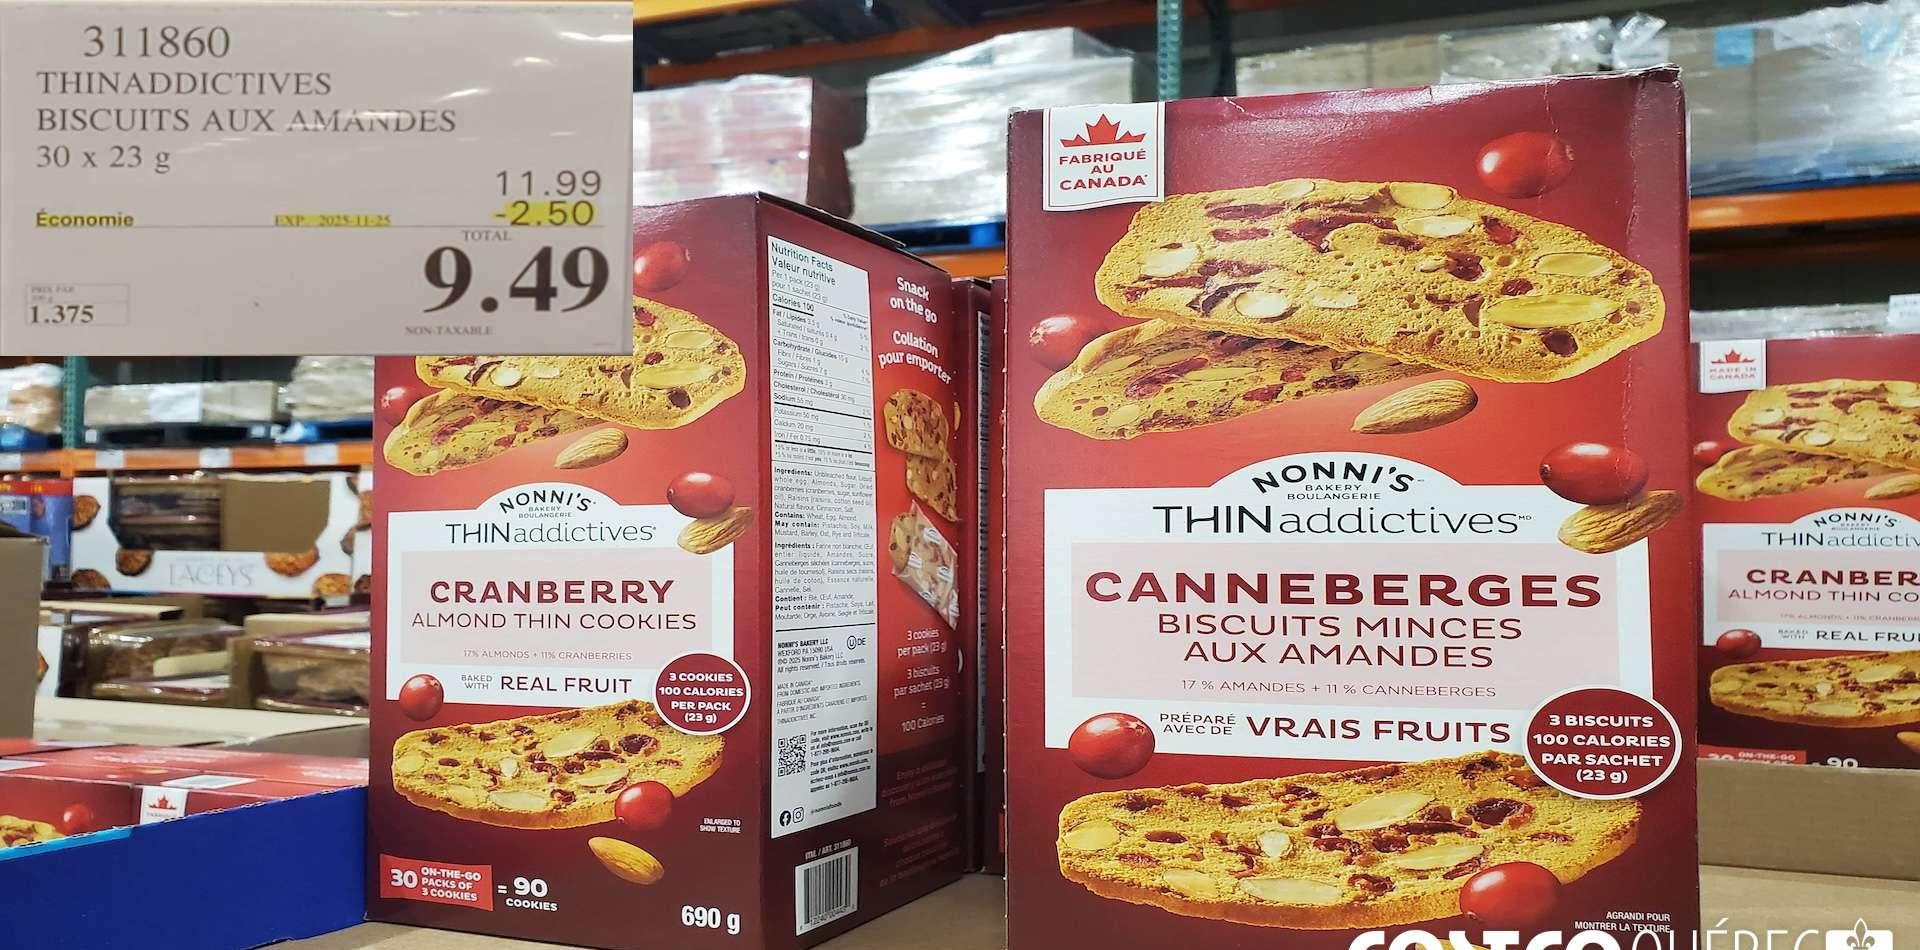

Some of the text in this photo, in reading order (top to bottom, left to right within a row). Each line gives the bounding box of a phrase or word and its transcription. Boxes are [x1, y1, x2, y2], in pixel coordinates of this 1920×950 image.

[84, 26, 230, 58] 311860
[36, 71, 331, 96] THINADDICTIVES
[37, 108, 456, 133] BISCUITS AUX AMANDES
[36, 146, 171, 173] 30 x 23 g
[1059, 148, 1147, 166] FABRIQUÉ
[1090, 164, 1114, 175] AU
[496, 170, 602, 197] 11.99
[1059, 175, 1146, 192] CANADA
[36, 210, 134, 228] Économie
[275, 215, 304, 227] EXP
[495, 201, 595, 227] -2.50
[462, 230, 512, 241] TOTAL
[771, 242, 833, 272] Nutrition Facts
[772, 255, 836, 286] Valeur nutritive
[423, 246, 609, 313] 9.49
[897, 277, 930, 301] Snack
[772, 293, 801, 308] Calories
[30, 304, 94, 324] 1.375
[890, 297, 938, 323] on the go
[893, 331, 938, 358] Collation
[878, 352, 952, 384] pour emporter
[1252, 461, 1414, 494] NONNI'S
[1305, 484, 1362, 492] BAKERY
[500, 489, 592, 514] NONNI'S
[1287, 493, 1381, 501] BOULANGERIE
[1152, 505, 1519, 535] THINaddictives
[1814, 512, 1897, 528] NONNI'S
[446, 521, 653, 544] THINaddictives
[430, 580, 674, 605] CRANBERRY
[1085, 571, 1601, 608] CANNEBERGES
[1728, 589, 1920, 602] ALMOND THIN CO
[411, 612, 696, 630] ALMOND THIN COOKIES
[1157, 613, 1522, 640] BISCUITS MINCES
[907, 628, 939, 640] 3 cookies
[1817, 630, 1868, 641] REAL
[558, 652, 632, 660] CRANBERRIES
[1183, 641, 1493, 668] AUX AMANDES
[464, 682, 489, 690] WITH
[501, 676, 632, 693] REAL FRUIT
[669, 673, 733, 682] 3 COOKIES
[659, 687, 744, 696] 100 CALORIES
[1181, 679, 1196, 690] 17
[1201, 681, 1215, 690] %
[1219, 681, 1305, 693] AMANDES
[1327, 684, 1338, 694] 11
[1343, 684, 1357, 695] %
[1362, 684, 1496, 697] CANNEBERGES
[671, 701, 731, 711] PER PACK
[685, 713, 717, 724] (23 g)
[1160, 711, 1235, 725] PRÉPARÉ
[1549, 715, 1653, 728] 3 BISCUITS
[1163, 724, 1233, 736] AVEC DE
[1246, 715, 1511, 743] VRAIS FRUITS
[1533, 734, 1671, 748] 100 CALORIES
[1541, 753, 1663, 767] PAR SACHET
[1576, 769, 1628, 784] (23 g)
[717, 825, 741, 834] TEXTURE
[390, 867, 482, 888] 30 ON-THE-GO
[421, 878, 473, 890] PACKS OF
[422, 888, 477, 901] 3 COOKIES
[513, 877, 548, 898] 90
[505, 898, 558, 912] COOKIES
[681, 905, 741, 935] 690 g
[1606, 911, 1671, 922] AGRANDI POUR
[1575, 921, 1617, 931] MONTRER
[1618, 922, 1631, 932] LA
